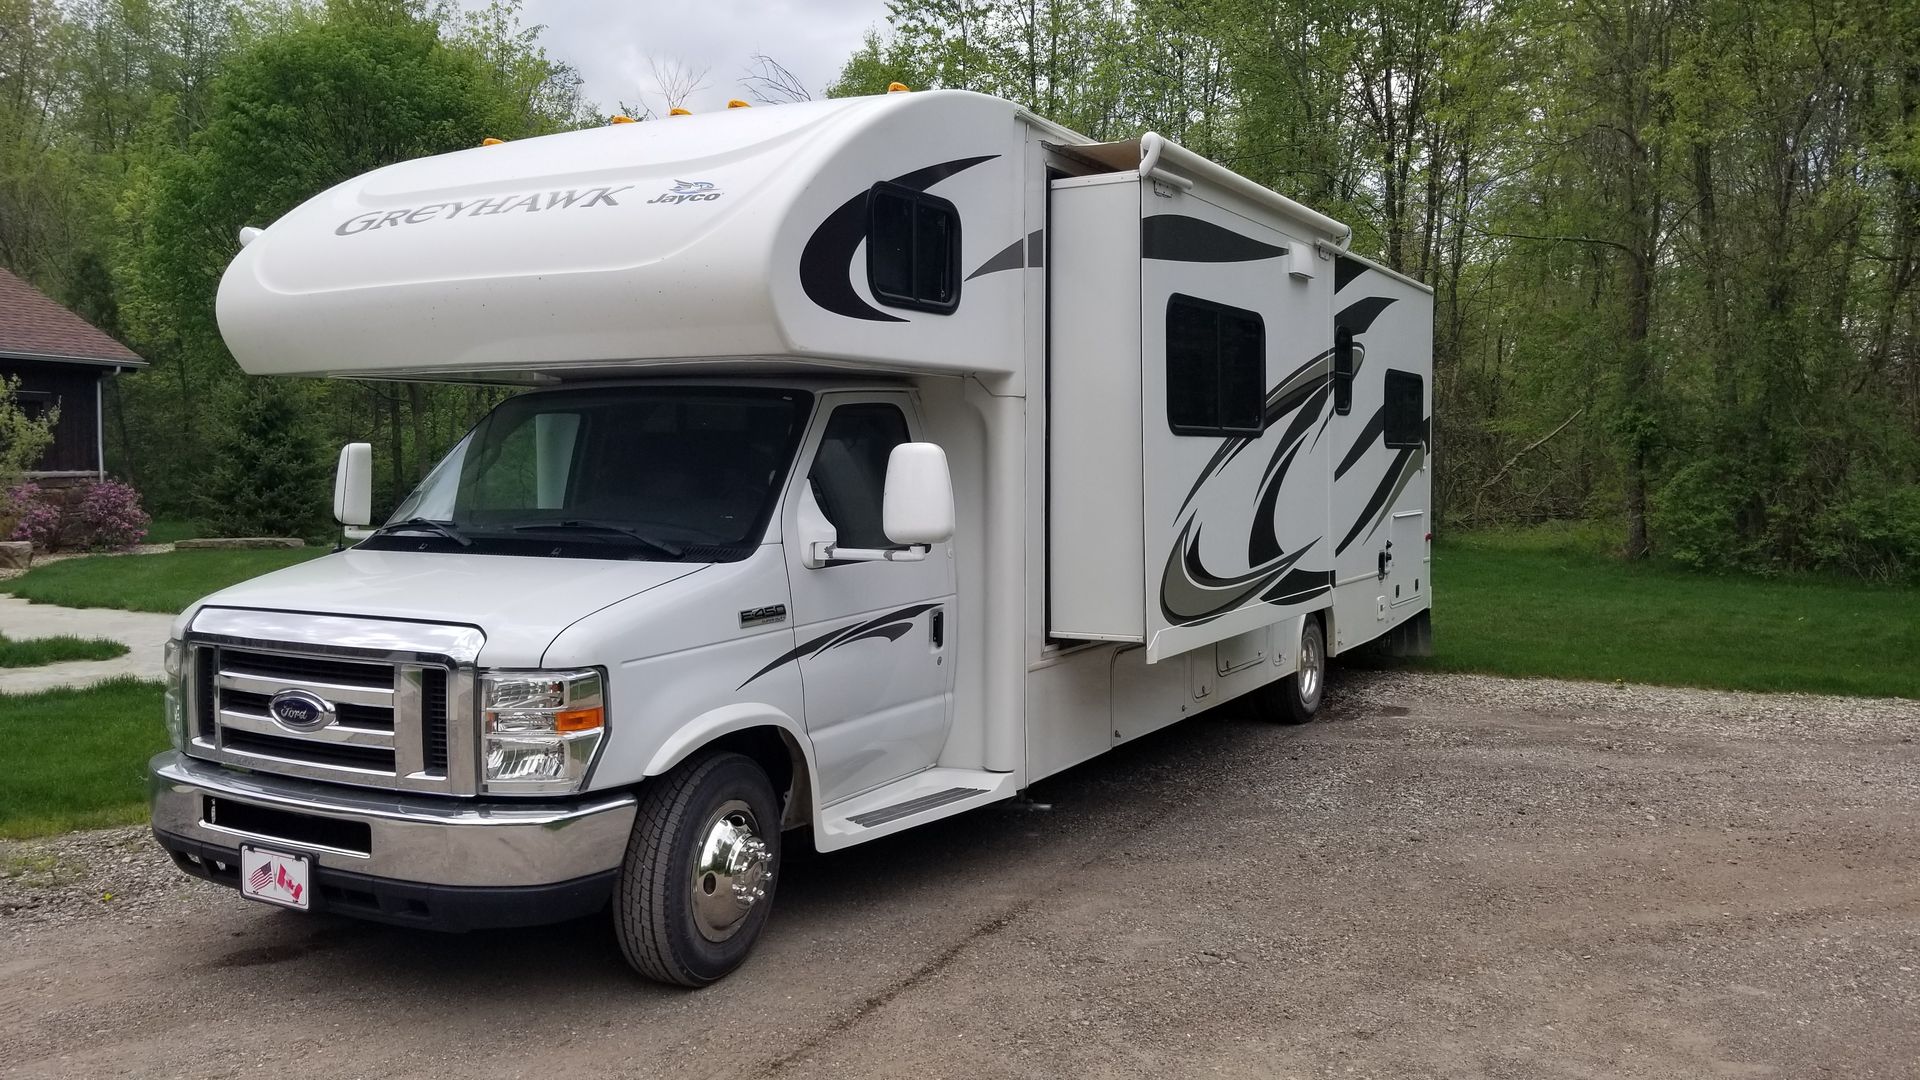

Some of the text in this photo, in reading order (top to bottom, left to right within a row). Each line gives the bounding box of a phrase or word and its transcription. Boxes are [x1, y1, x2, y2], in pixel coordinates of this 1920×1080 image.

[647, 192, 721, 205] Jayco
[335, 185, 635, 236] GREYHAWK
[280, 704, 308, 720] Ford
